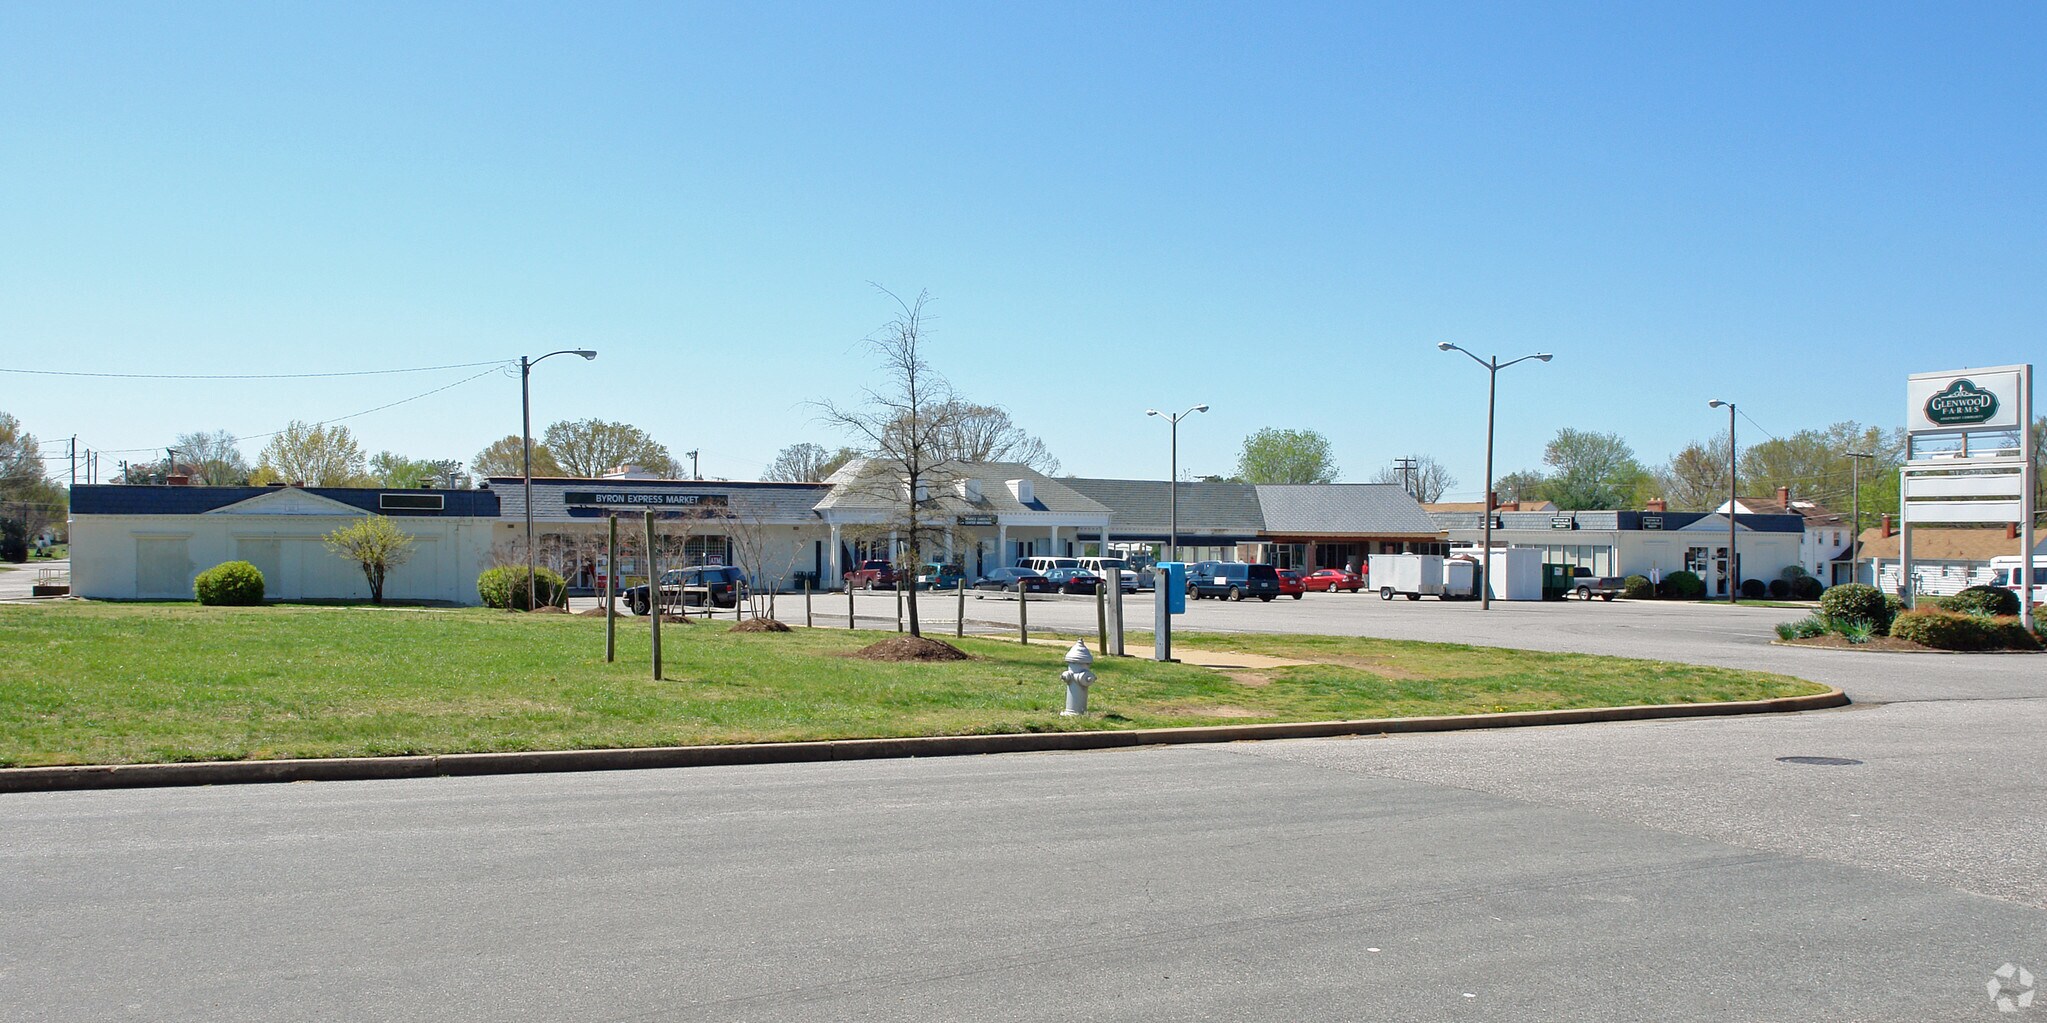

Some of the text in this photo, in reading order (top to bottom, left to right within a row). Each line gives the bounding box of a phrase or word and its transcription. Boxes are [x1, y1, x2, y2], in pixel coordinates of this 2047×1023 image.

[1932, 394, 1991, 410] GLENWOOD
[595, 494, 699, 504] BYRON EXPRESS MARKET
